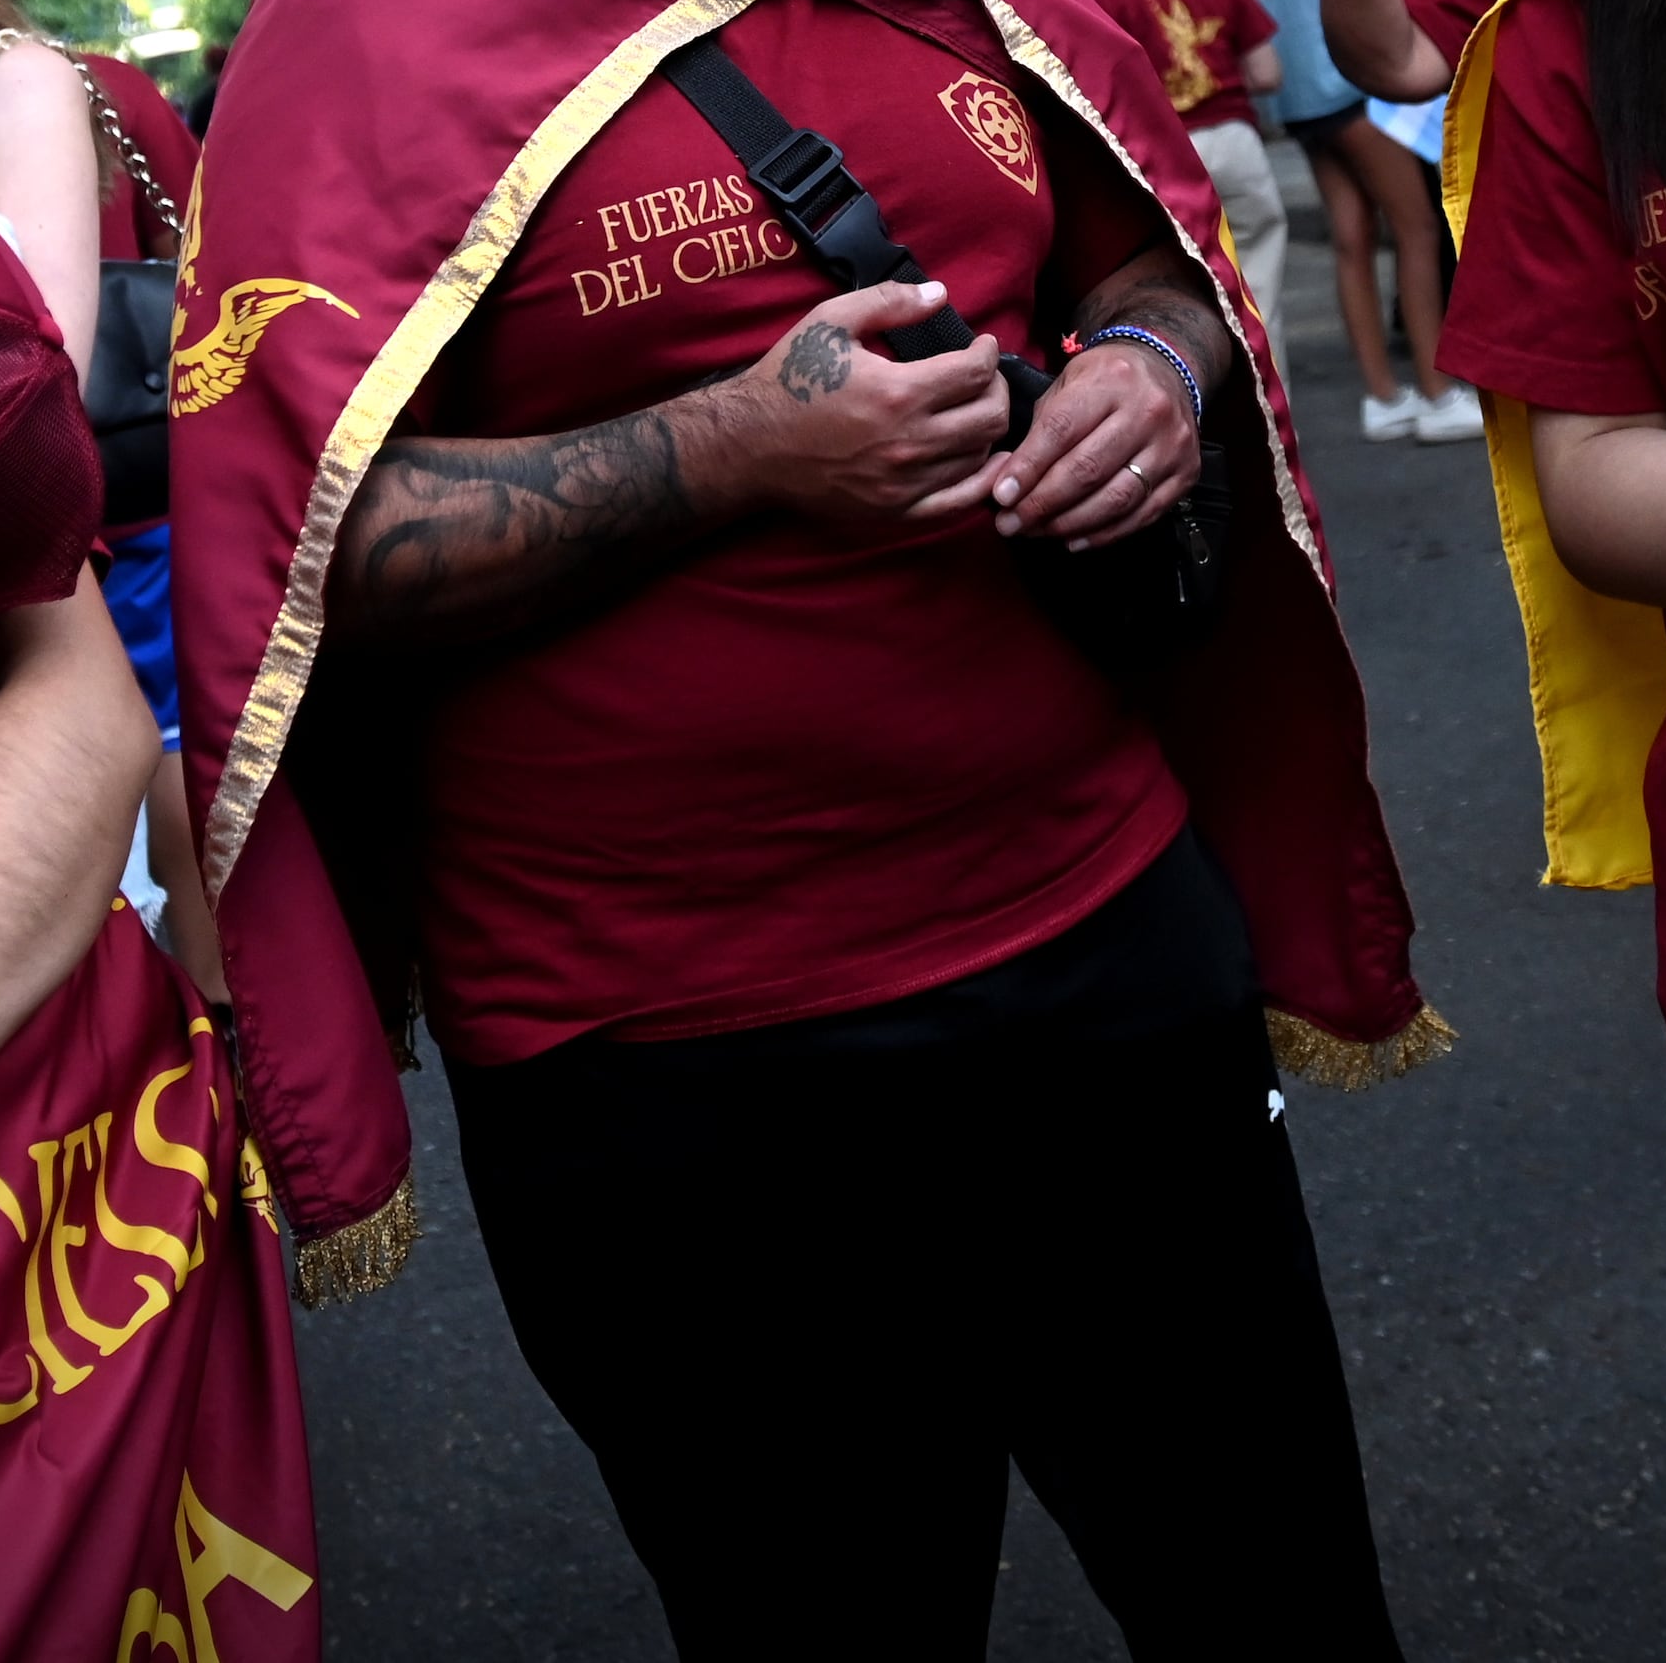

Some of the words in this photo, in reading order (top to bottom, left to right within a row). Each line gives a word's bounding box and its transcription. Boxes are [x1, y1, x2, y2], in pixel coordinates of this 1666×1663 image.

[597, 174, 754, 253] FUERZAS
[571, 254, 662, 317] DEL
[672, 218, 798, 284] CIELO
